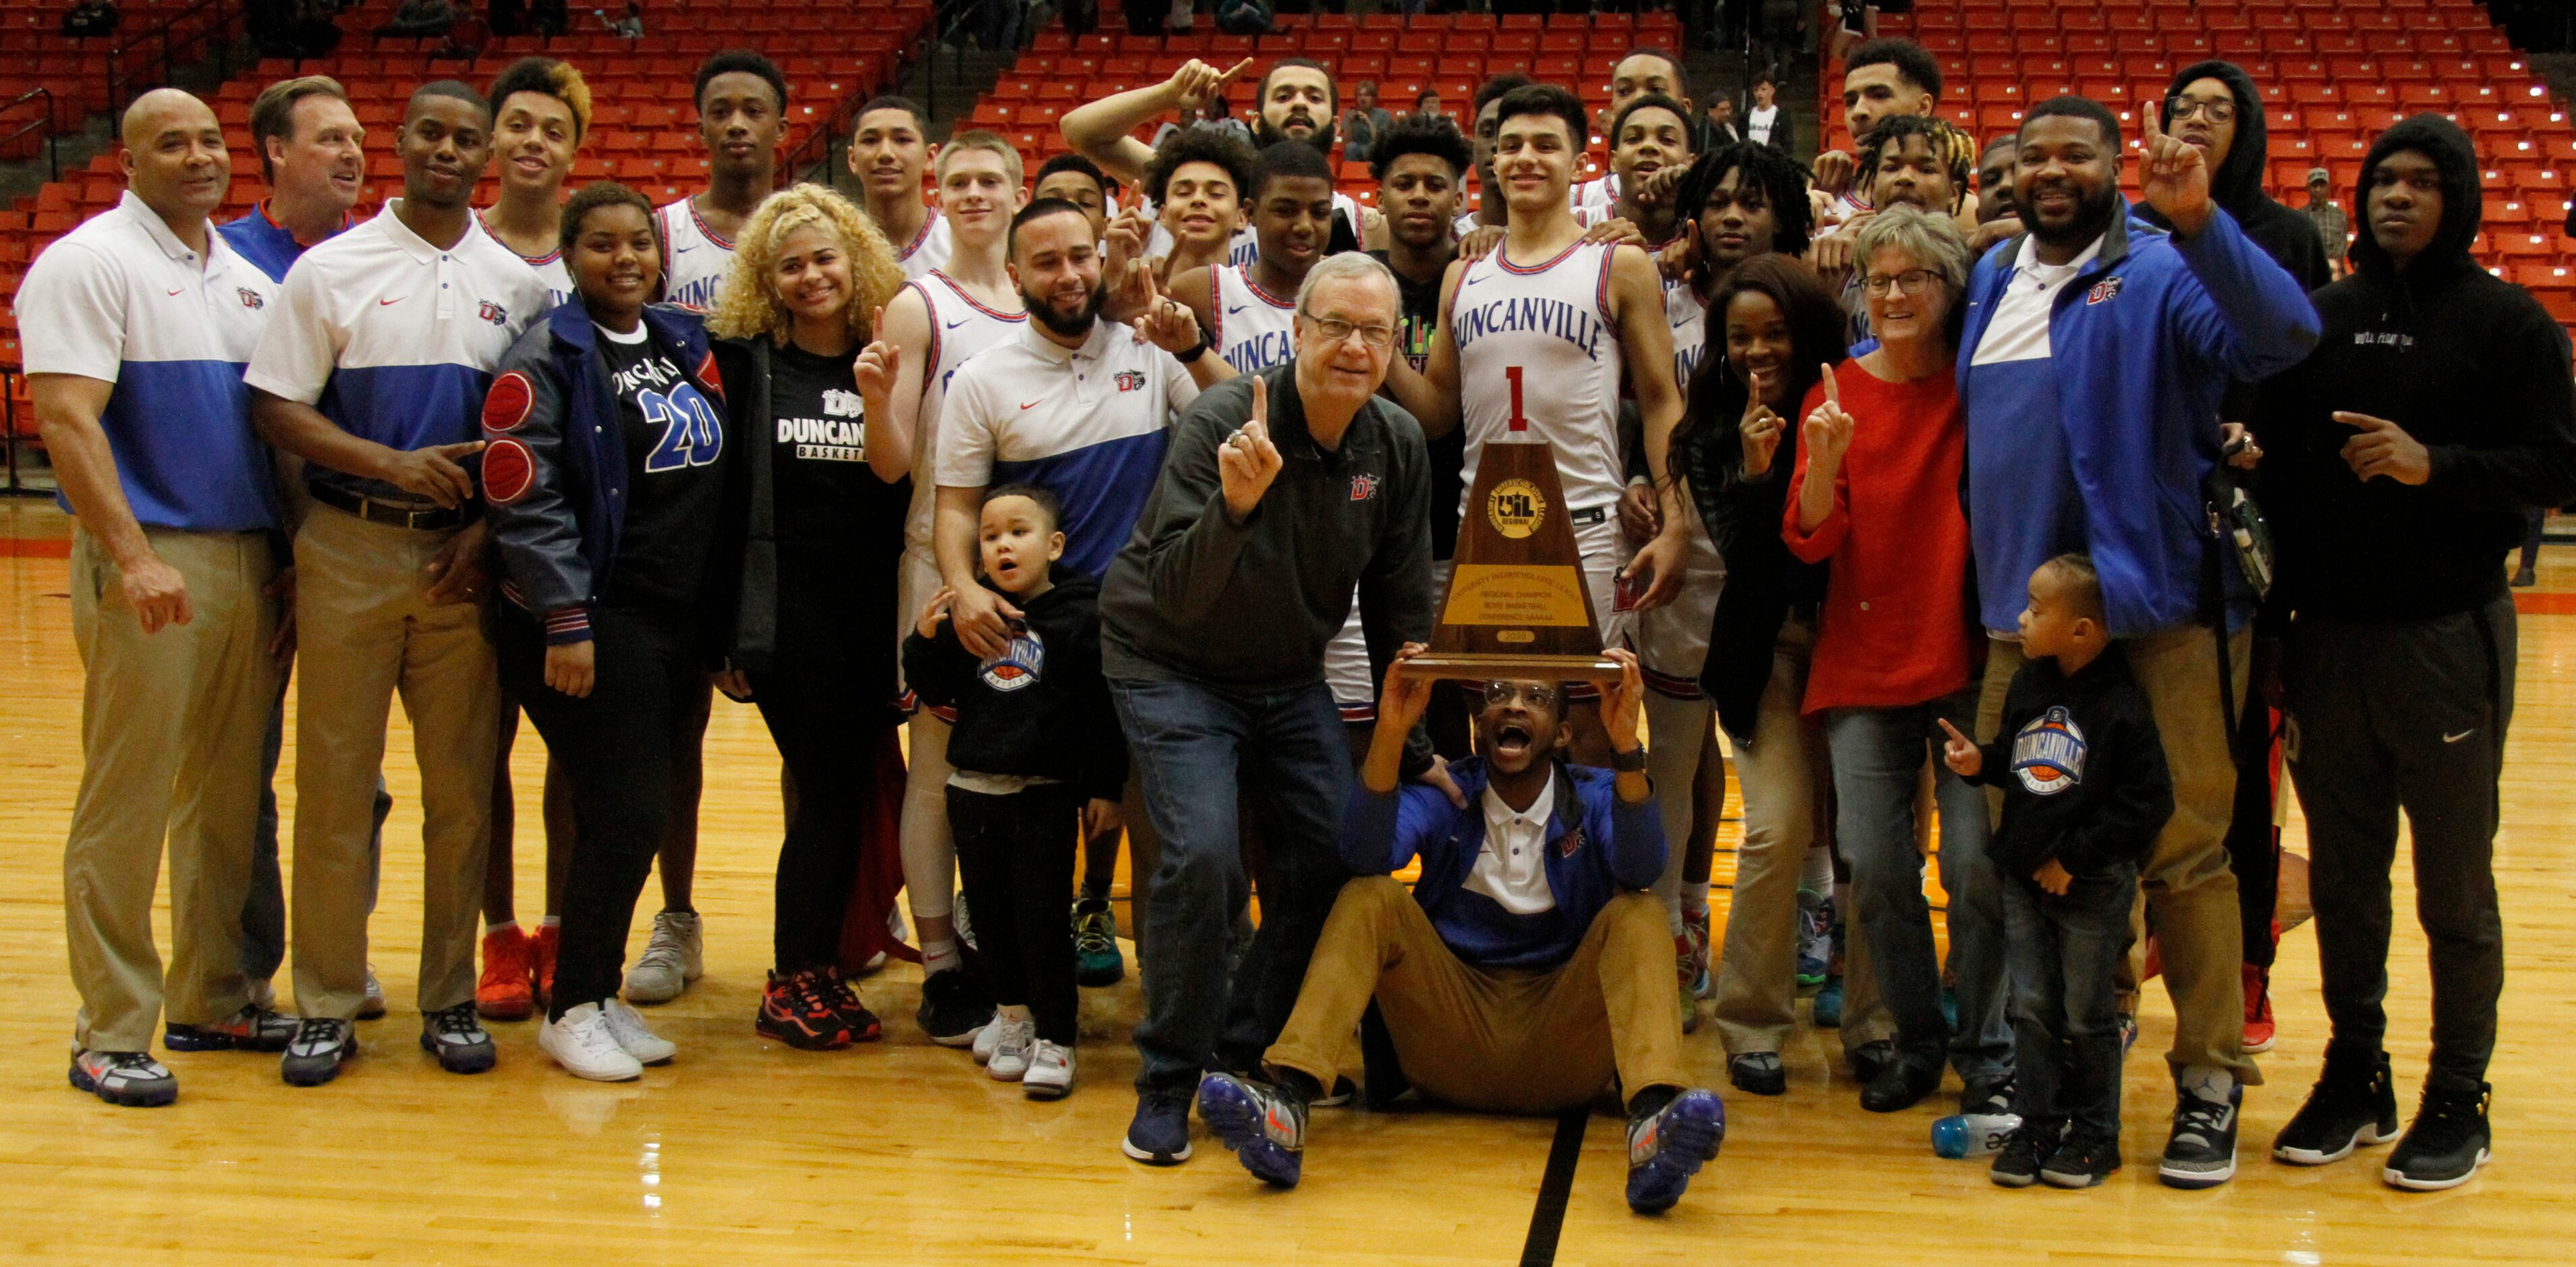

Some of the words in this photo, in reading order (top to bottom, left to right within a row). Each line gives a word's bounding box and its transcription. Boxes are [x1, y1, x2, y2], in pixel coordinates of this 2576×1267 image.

[1506, 366, 1528, 431] 1
[637, 381, 723, 473] 20
[777, 418, 866, 446] DUNCAN
[799, 447, 866, 460] BASKET
[1480, 590, 1513, 598] REGIONAL
[1478, 613, 1523, 621] CONFERENCE
[1505, 632, 1527, 640] 2020
[2015, 731, 2083, 777] DUNCANVILLE
